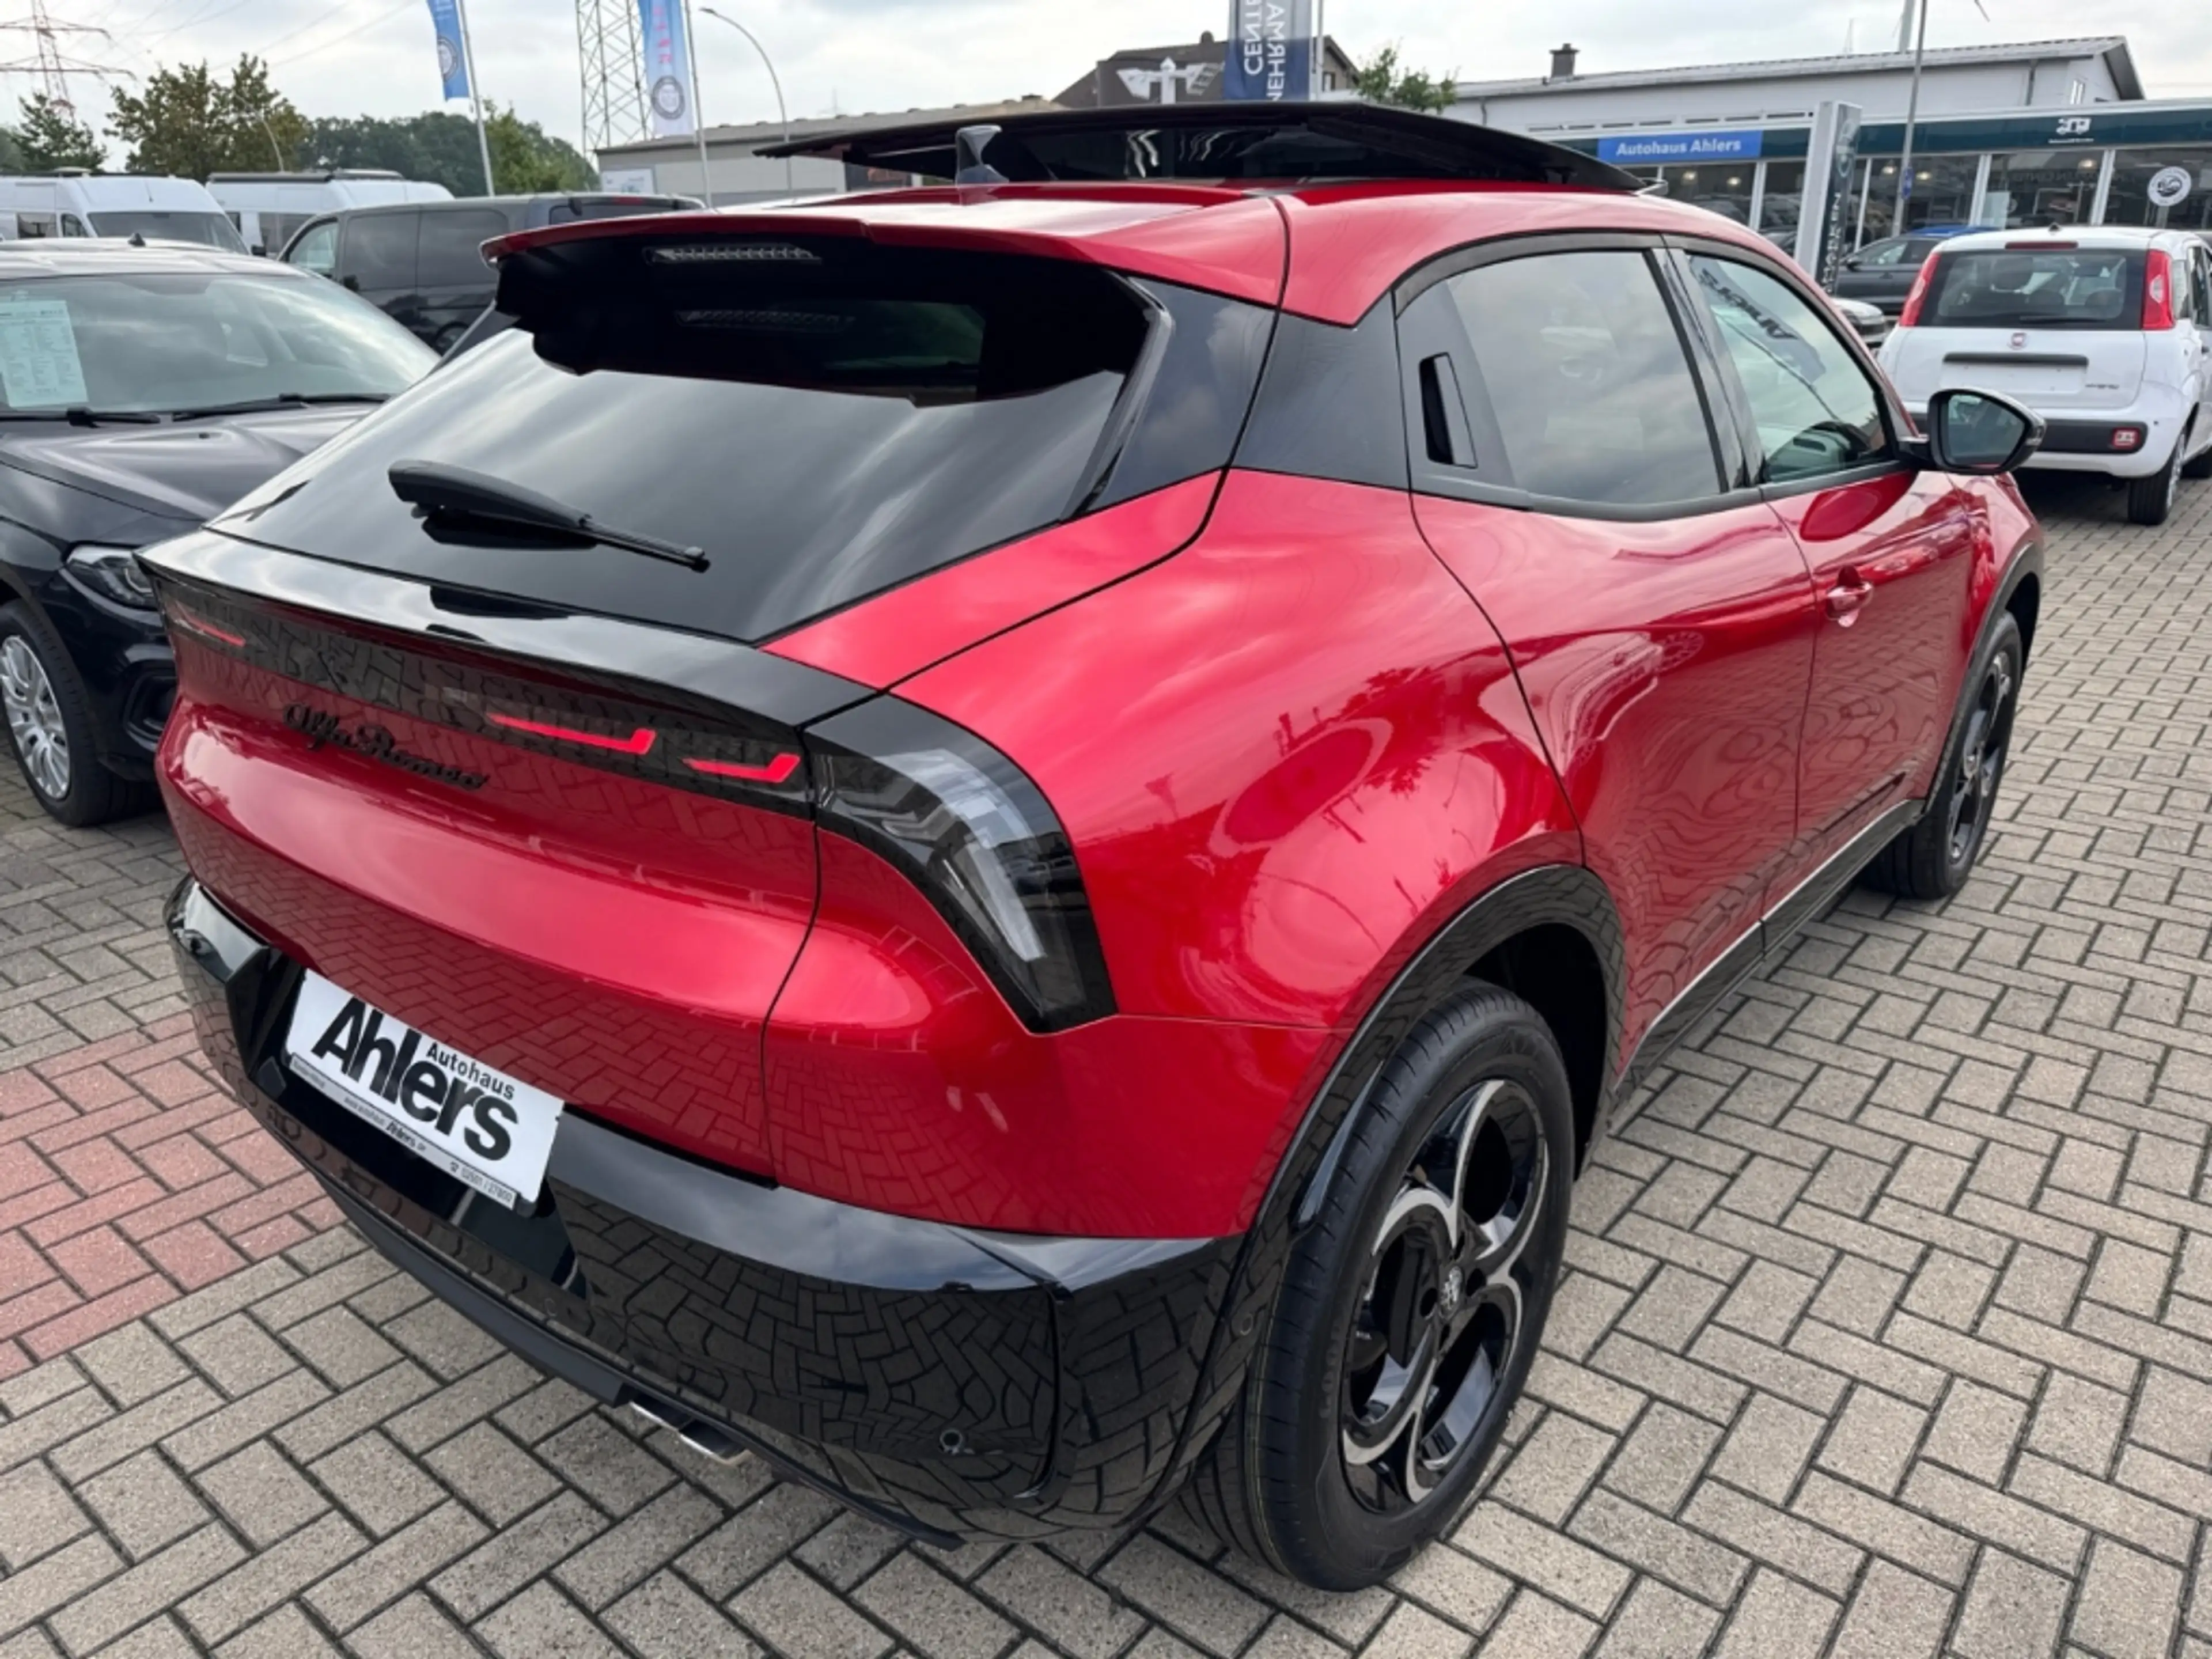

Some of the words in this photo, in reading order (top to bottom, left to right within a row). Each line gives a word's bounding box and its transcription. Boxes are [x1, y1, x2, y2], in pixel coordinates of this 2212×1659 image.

[1616, 141, 1687, 156] Autohaus
[1690, 138, 1741, 153] Ahlers
[285, 703, 354, 749] Alfa
[349, 724, 491, 791] Romeo
[310, 997, 519, 1161] Ahlers
[426, 1041, 515, 1100] Autohaus
